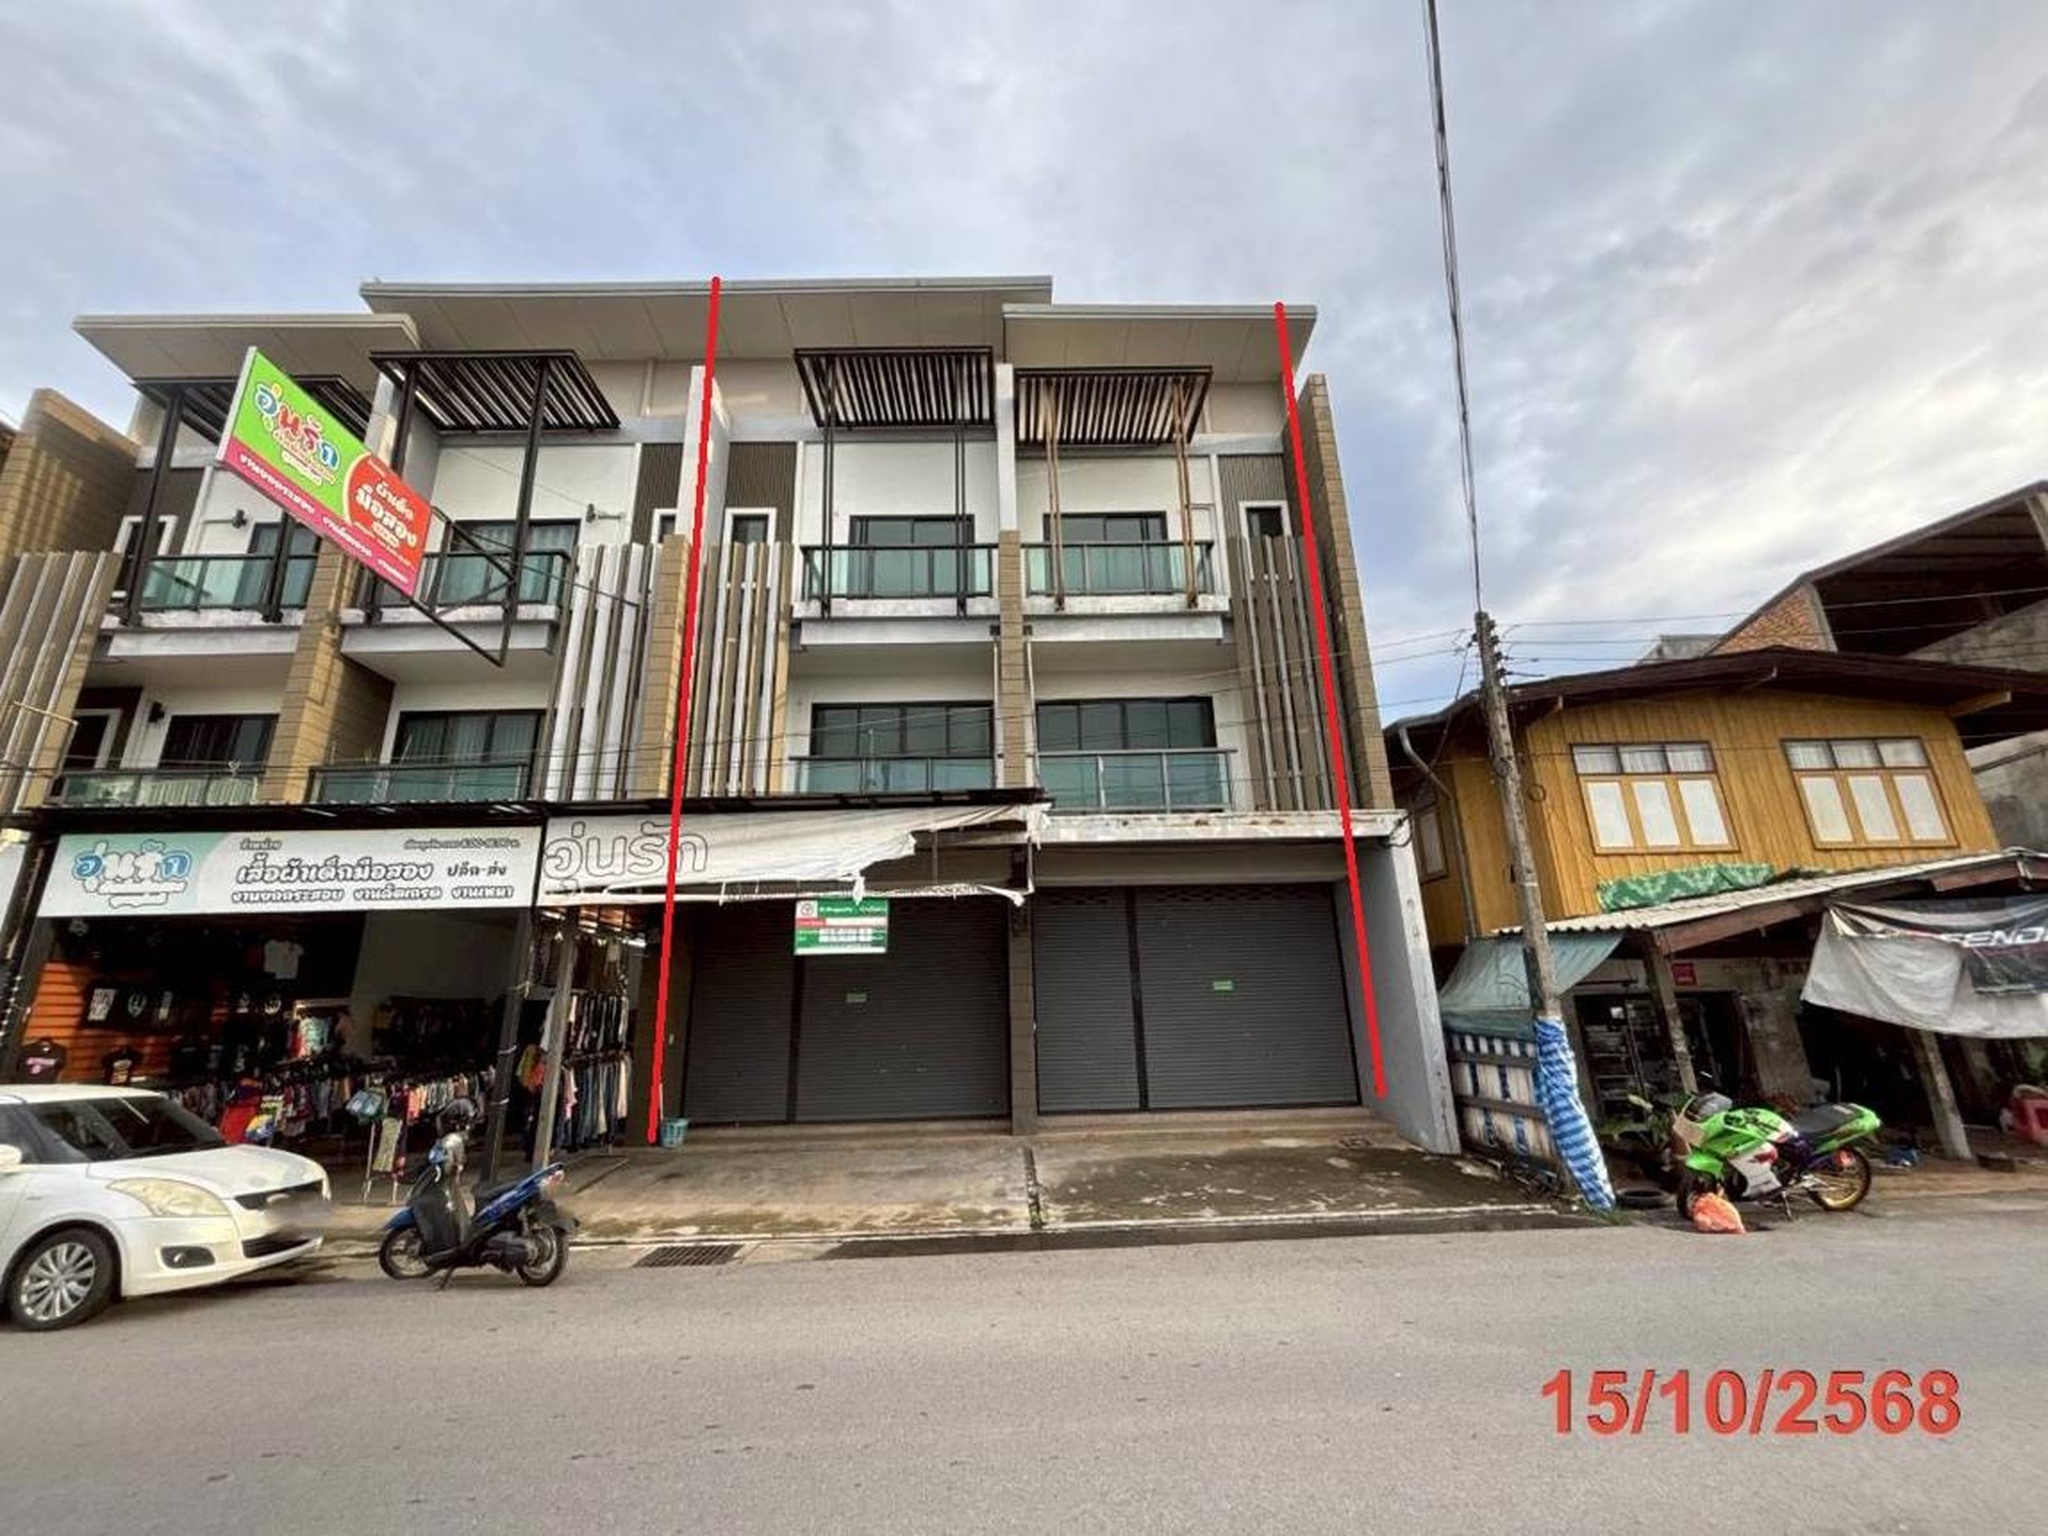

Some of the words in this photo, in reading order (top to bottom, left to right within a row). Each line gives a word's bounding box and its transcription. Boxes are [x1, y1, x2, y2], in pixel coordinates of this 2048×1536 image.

[254, 382, 340, 470] อุ่นรัก
[355, 484, 417, 548] มือสอง
[71, 839, 192, 893] อุ่นรัก
[235, 852, 434, 885] เสื้อผ้าเด็กมือสอง
